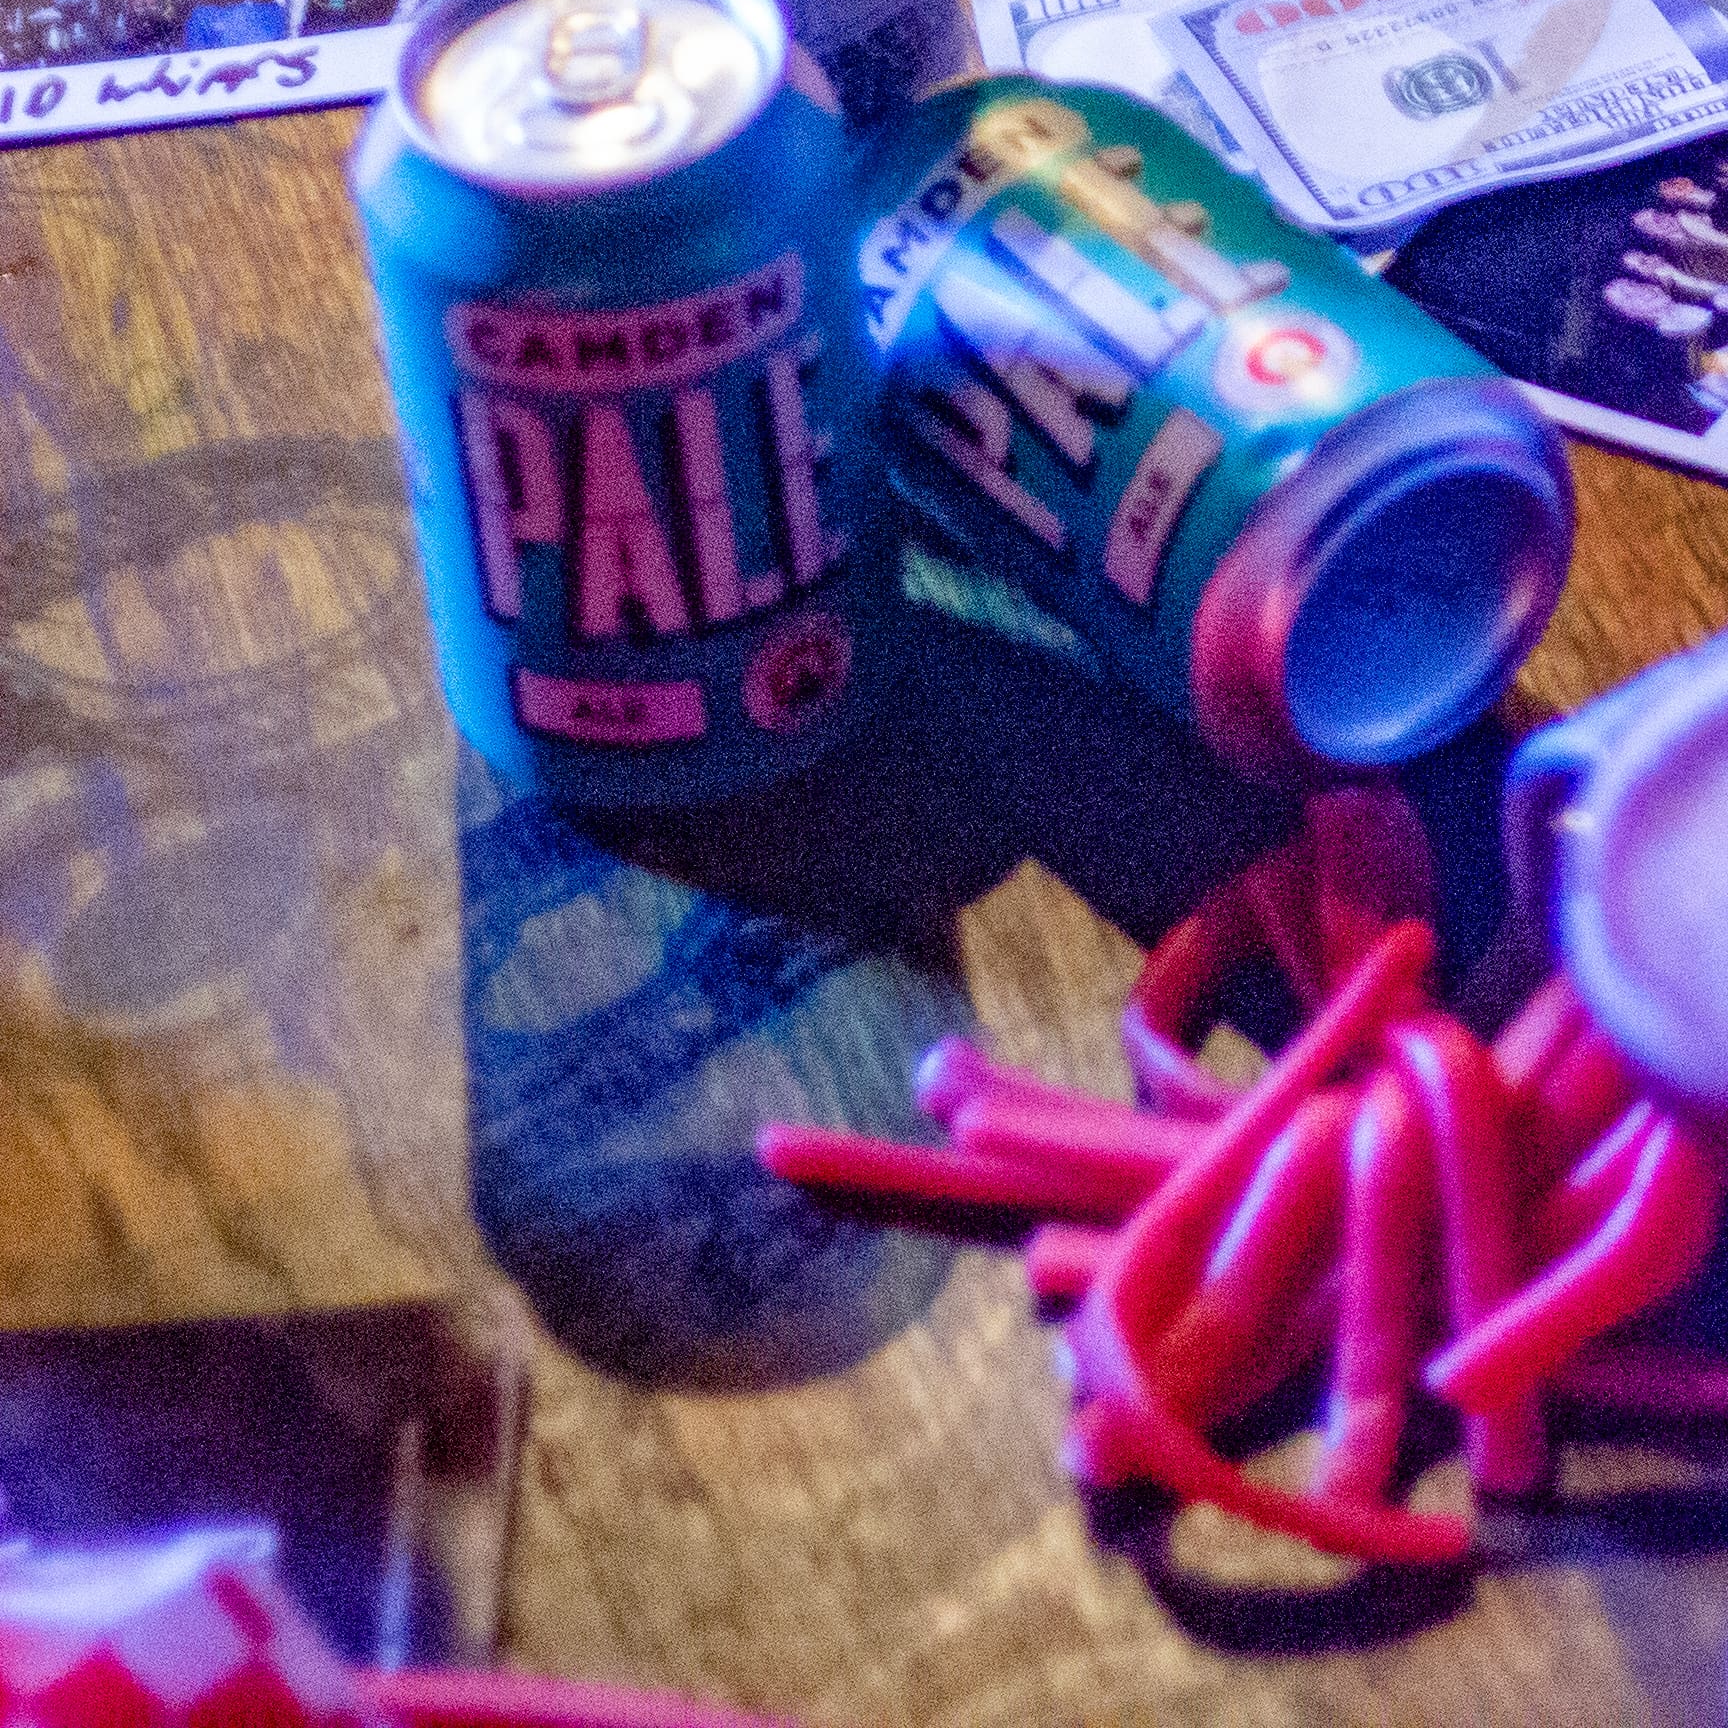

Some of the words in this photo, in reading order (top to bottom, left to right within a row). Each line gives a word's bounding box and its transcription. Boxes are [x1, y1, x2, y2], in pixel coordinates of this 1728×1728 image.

[467, 273, 784, 369] CAMDEN
[862, 106, 1056, 328] AMDEN
[462, 332, 849, 636] PALE
